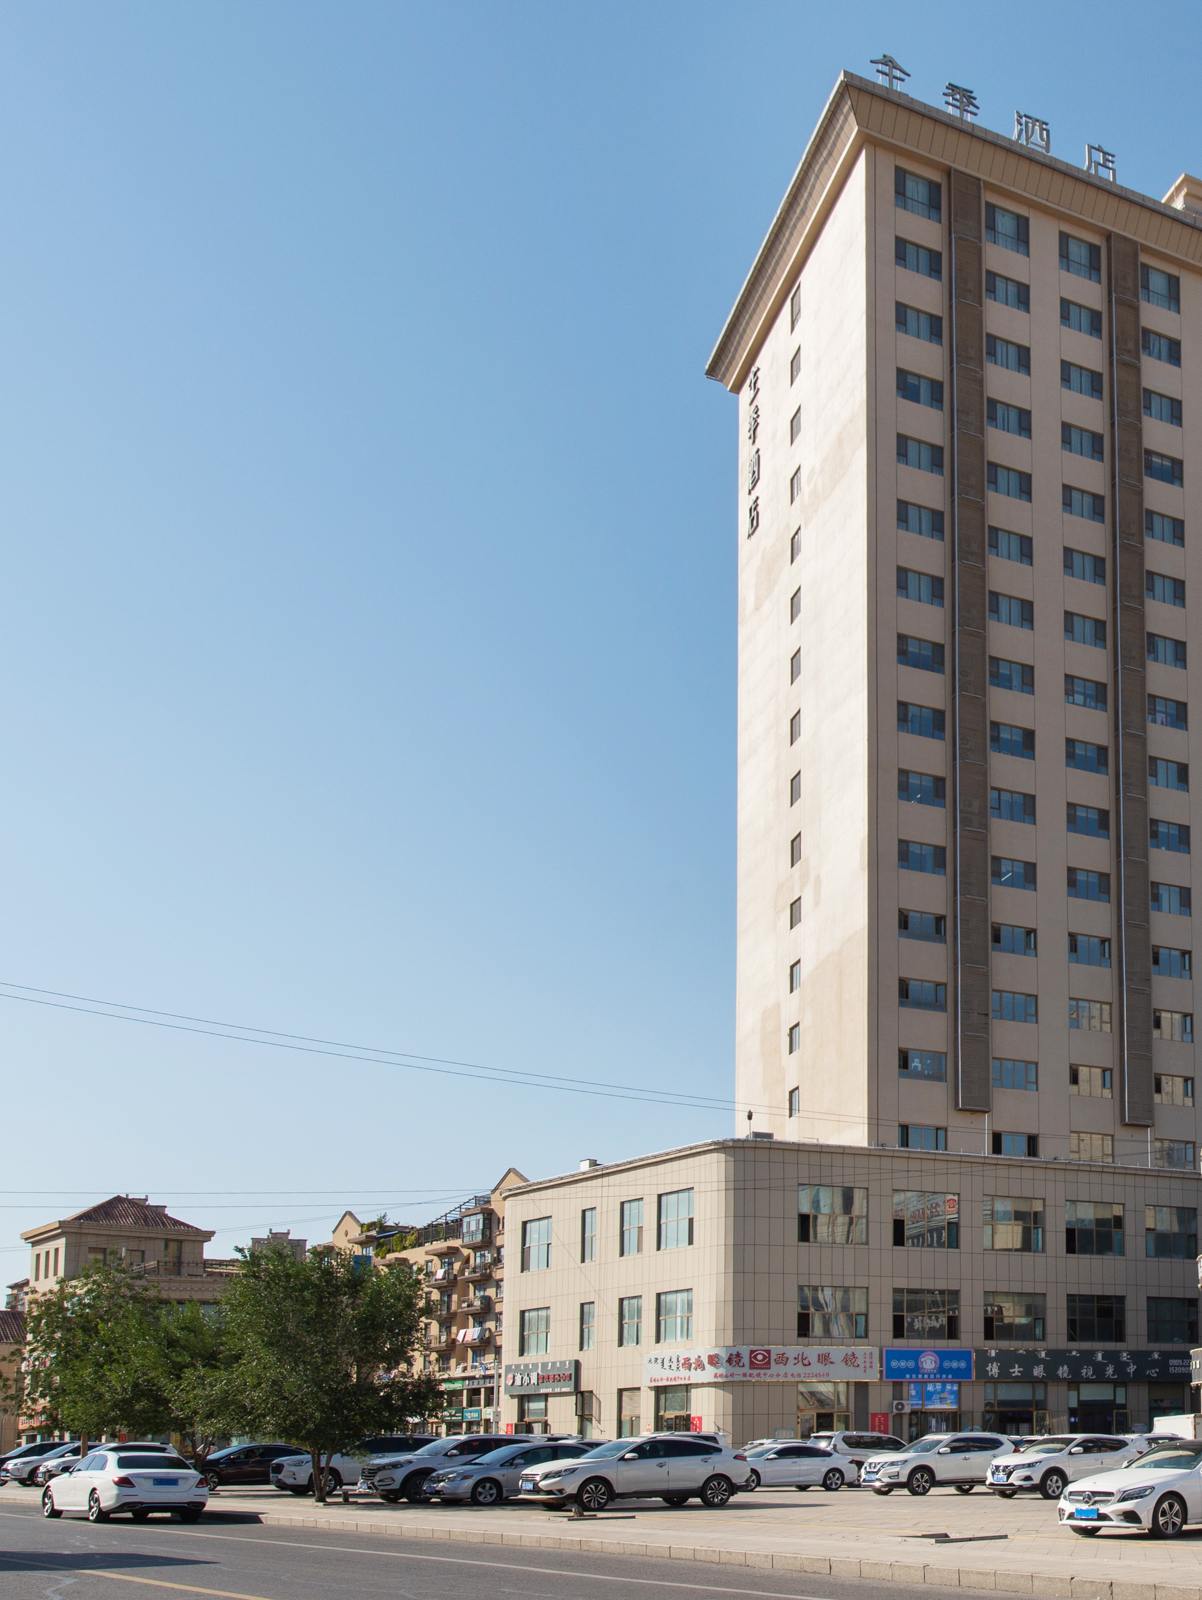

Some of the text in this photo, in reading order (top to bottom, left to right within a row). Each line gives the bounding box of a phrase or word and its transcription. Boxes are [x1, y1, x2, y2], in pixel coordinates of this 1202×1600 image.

[869, 54, 1116, 182] 全季酒店
[681, 1350, 746, 1373] 西北眼镜
[774, 1351, 860, 1368] 西北眼镜
